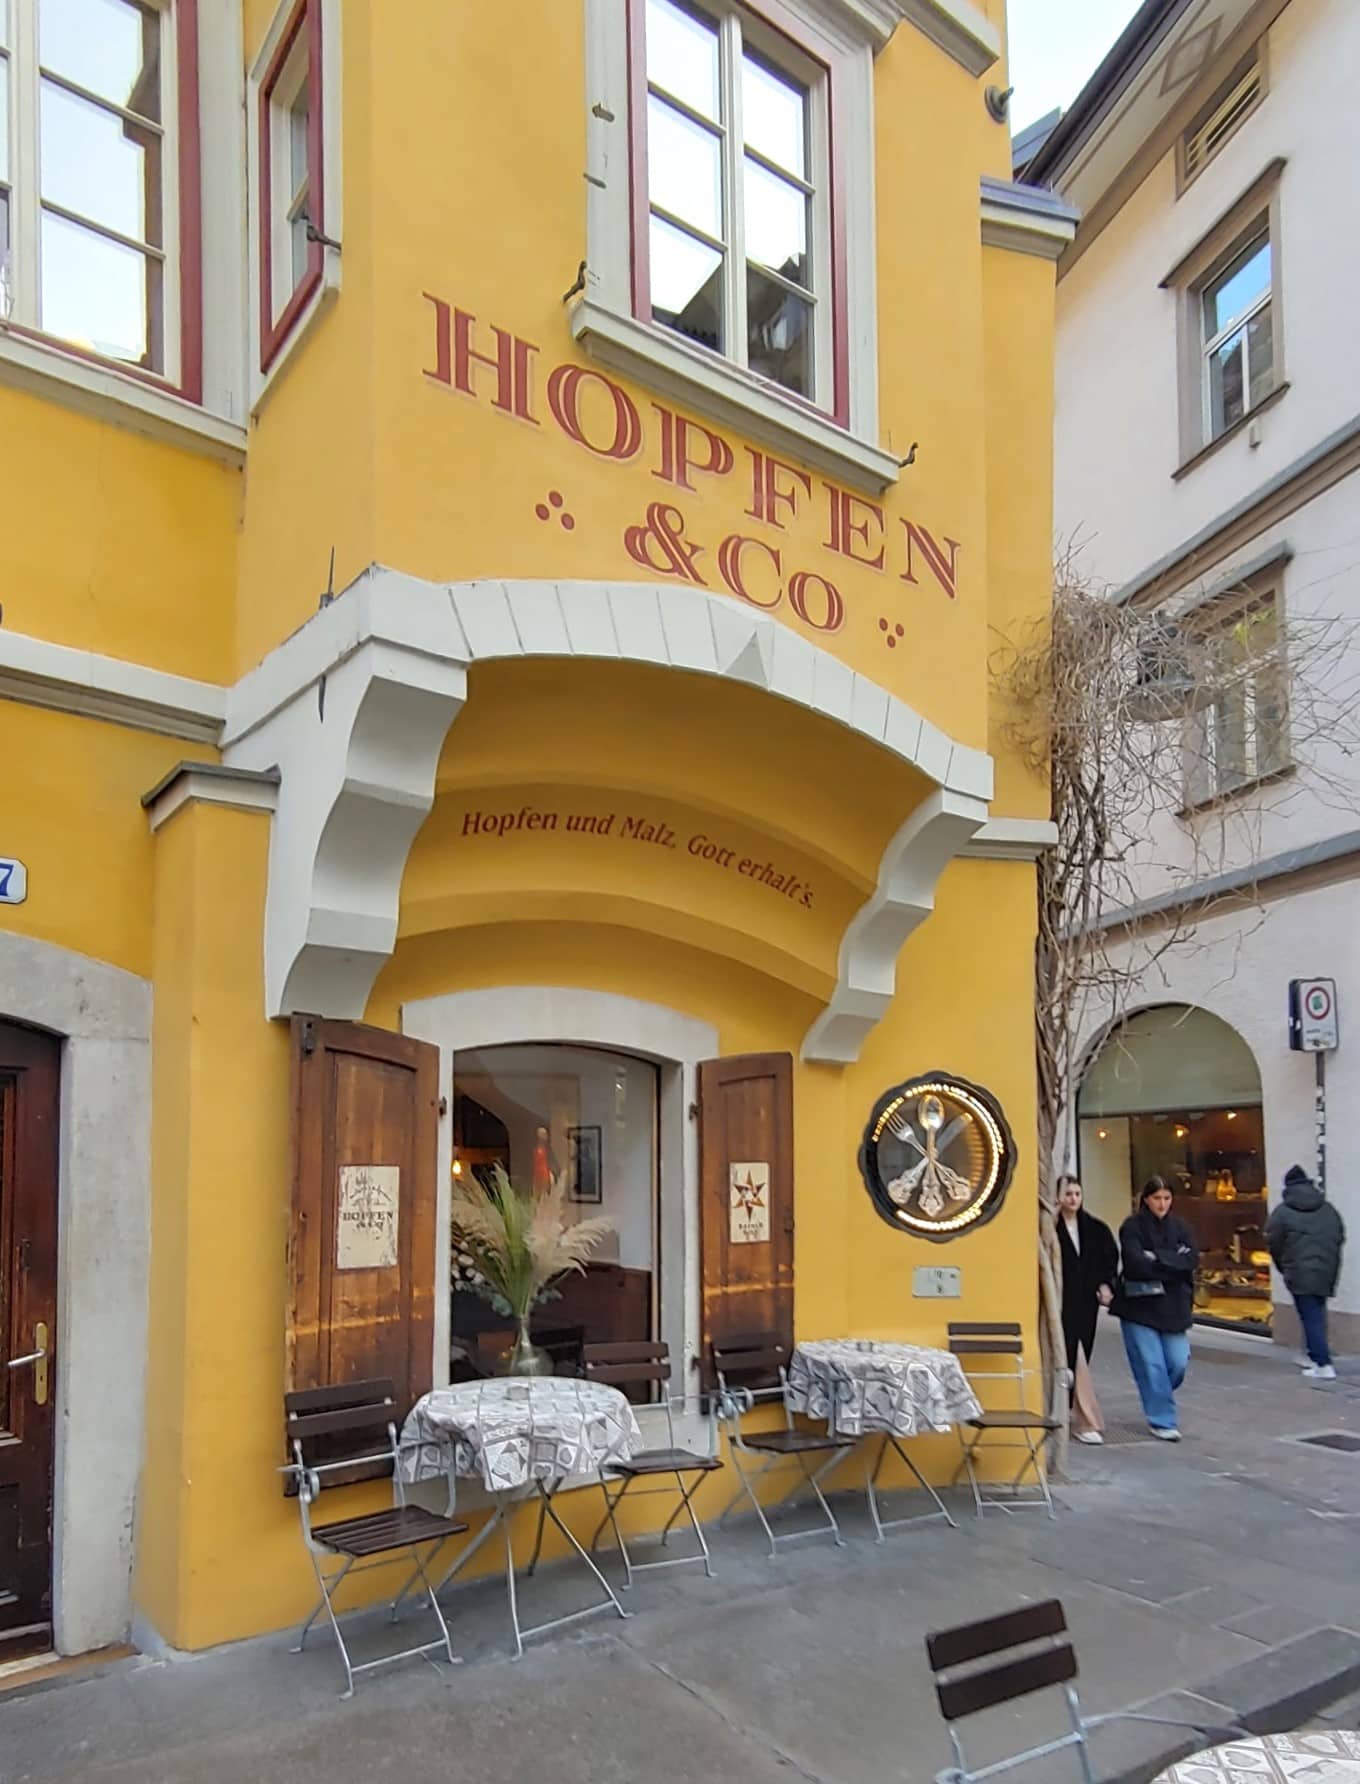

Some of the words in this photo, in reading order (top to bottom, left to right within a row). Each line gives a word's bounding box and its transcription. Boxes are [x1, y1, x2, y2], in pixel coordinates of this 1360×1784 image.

[422, 292, 961, 598] HOPFEN
[461, 807, 558, 837] Hopfen
[566, 813, 614, 836] und
[687, 834, 735, 868] Gott
